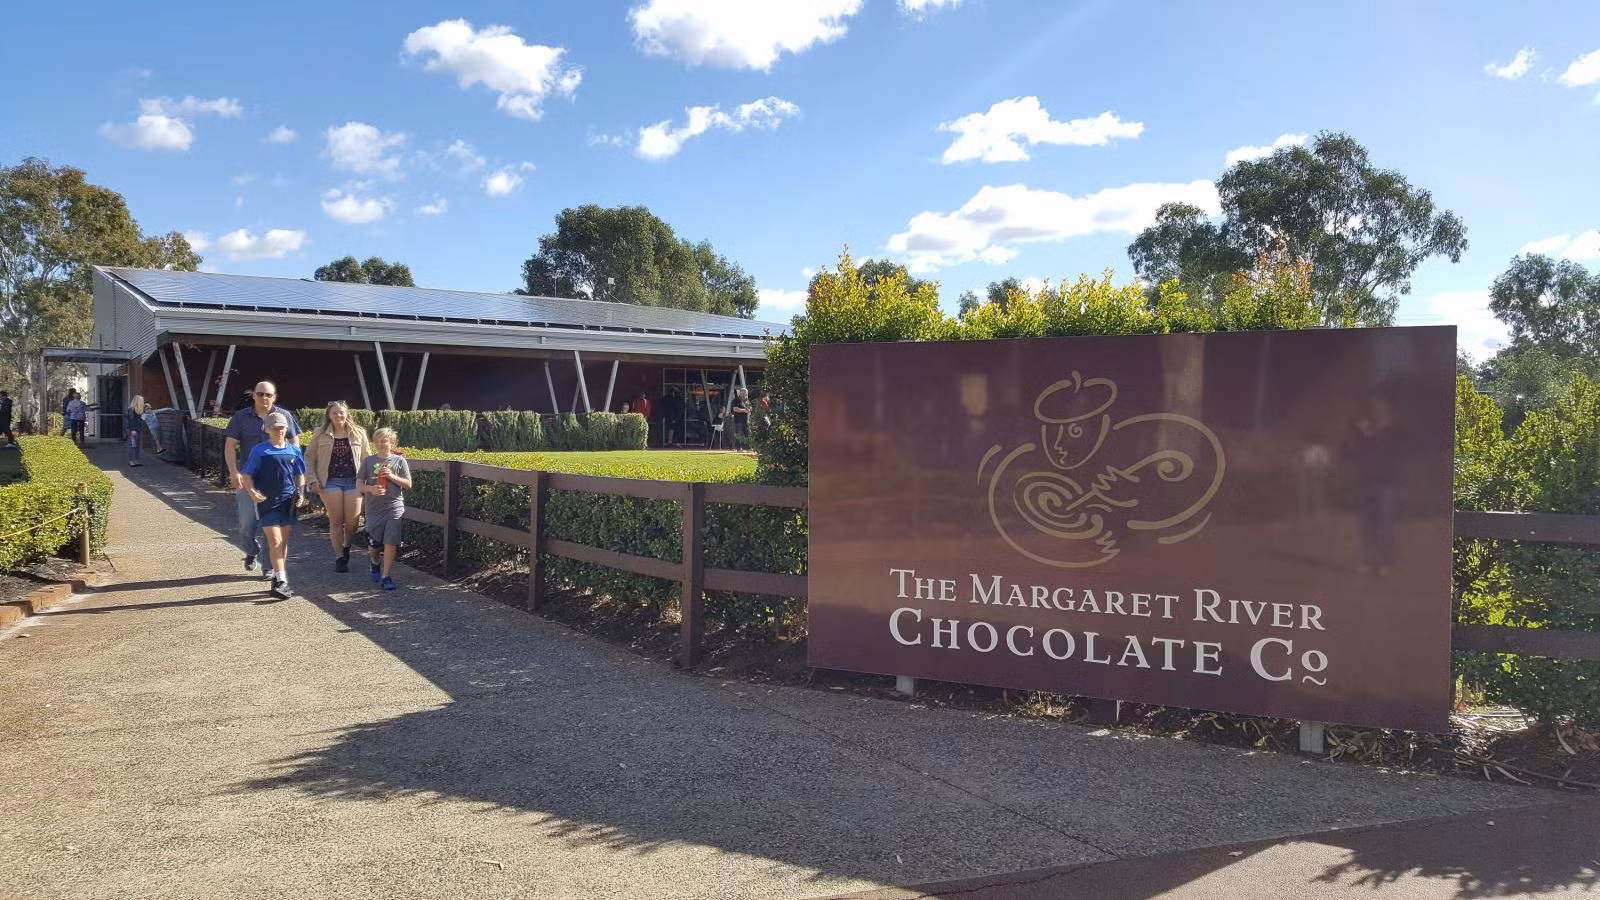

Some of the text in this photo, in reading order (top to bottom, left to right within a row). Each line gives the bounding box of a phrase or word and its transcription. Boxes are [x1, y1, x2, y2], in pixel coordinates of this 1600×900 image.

[889, 568, 1326, 630] THE MARGARET RIVER
[889, 607, 1223, 676] CHOCOLATE
